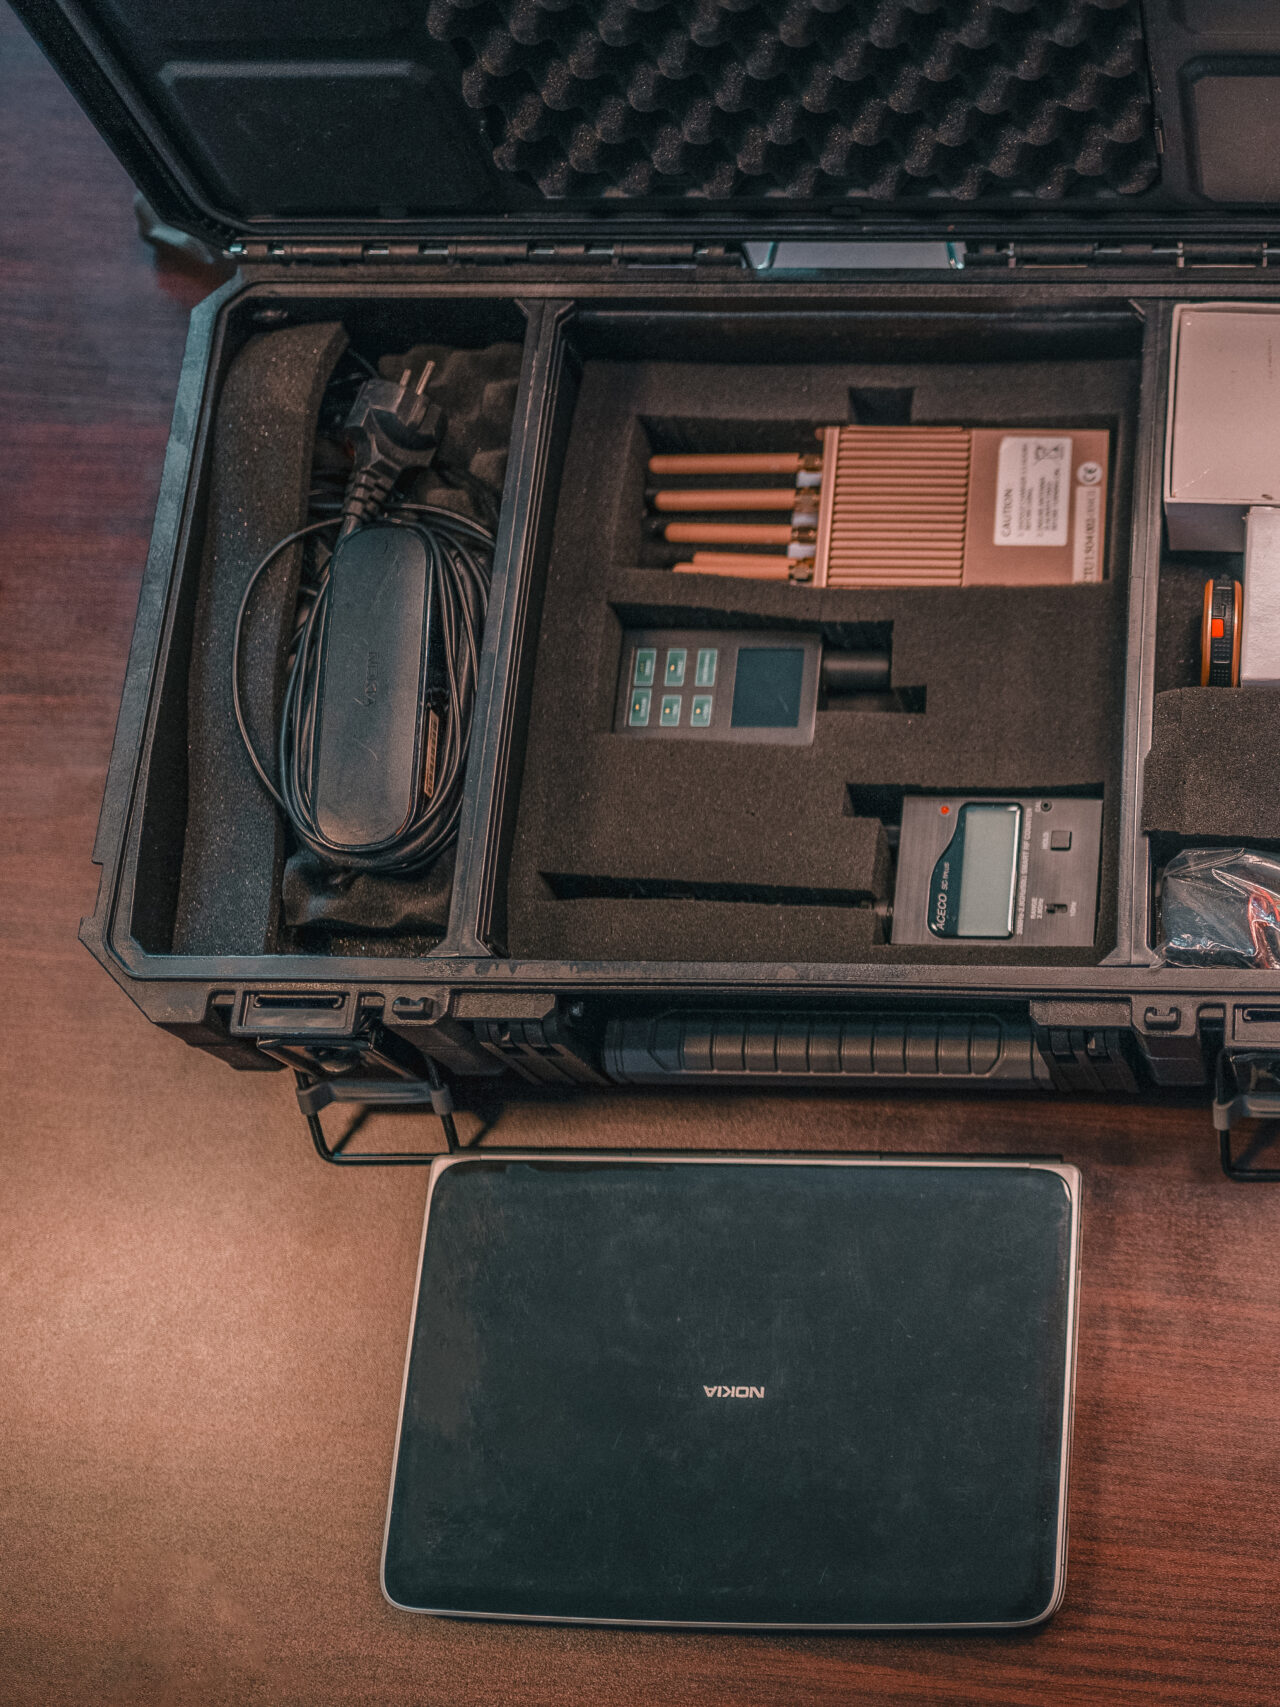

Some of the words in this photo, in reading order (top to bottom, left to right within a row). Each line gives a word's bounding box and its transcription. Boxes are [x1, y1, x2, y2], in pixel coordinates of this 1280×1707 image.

[1001, 487, 1014, 538] CAUTION
[936, 893, 948, 931] ACECO
[702, 1385, 765, 1399] NOKIA
